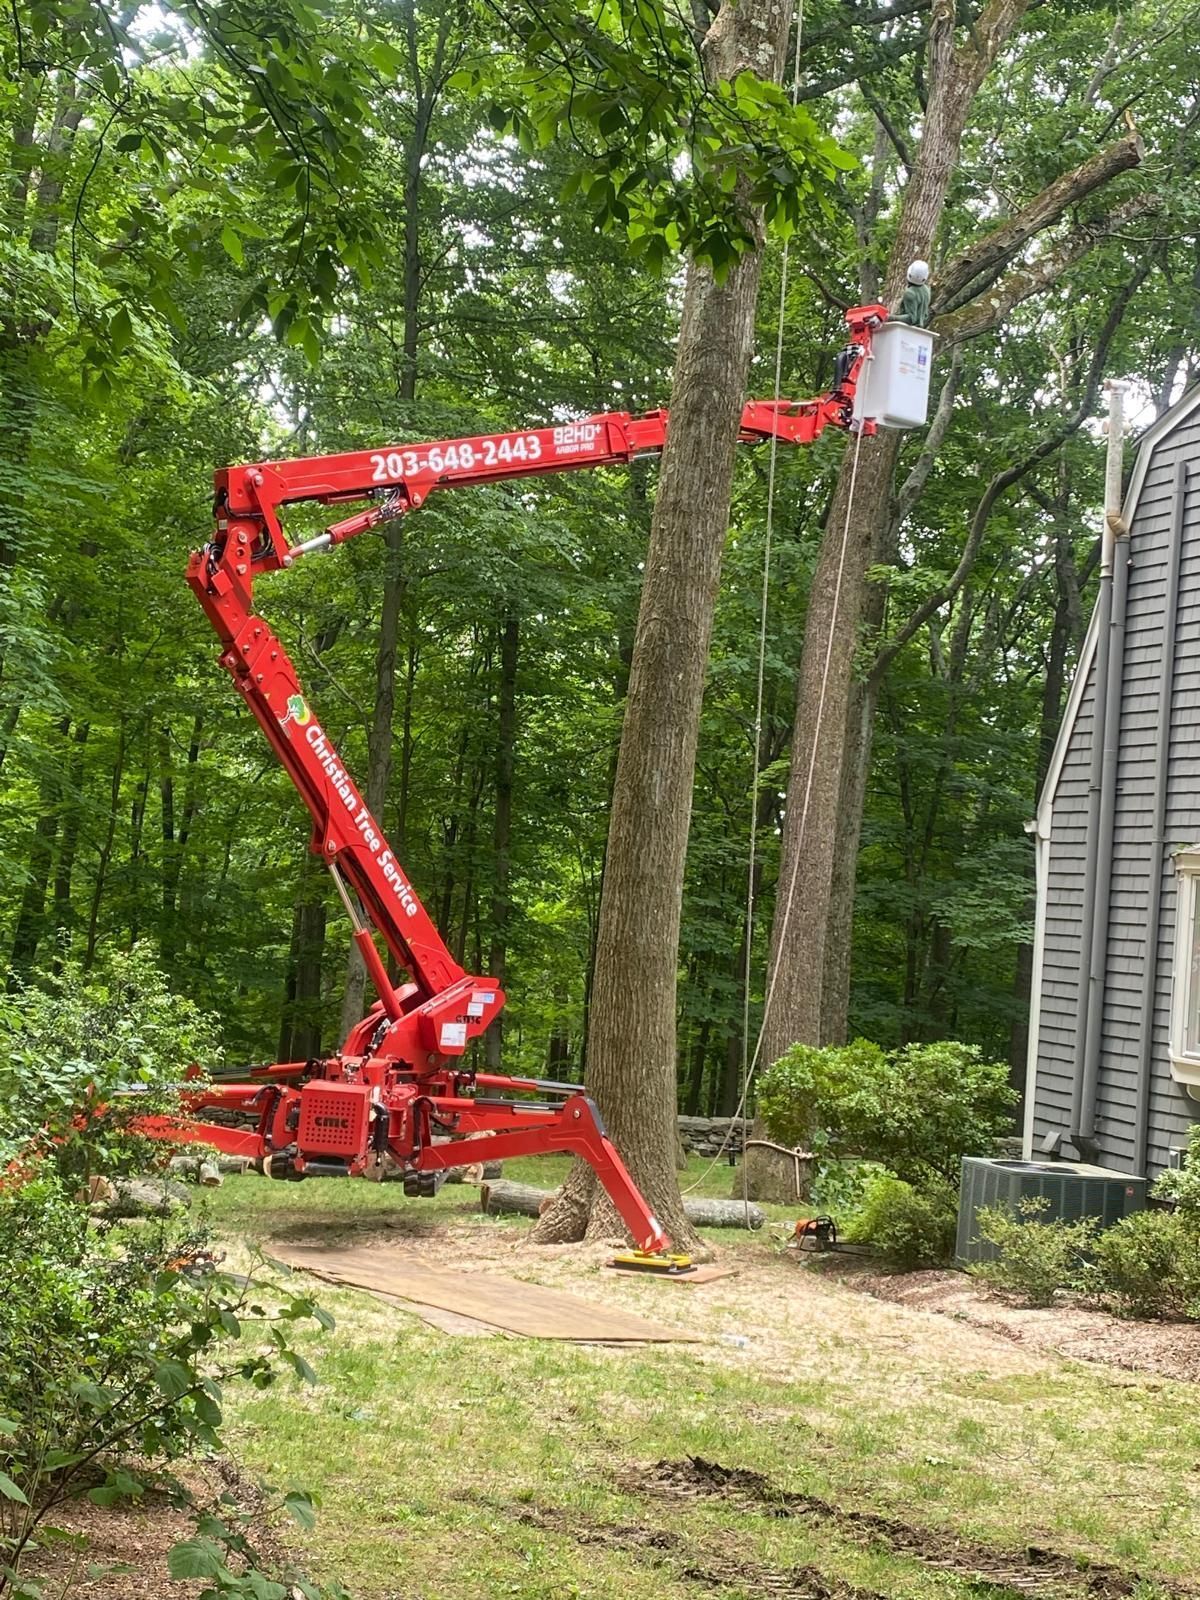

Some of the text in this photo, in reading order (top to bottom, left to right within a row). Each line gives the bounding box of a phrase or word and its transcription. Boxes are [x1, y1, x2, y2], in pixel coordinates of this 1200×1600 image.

[370, 435, 542, 481] 203-648-2443
[580, 442, 595, 452] PRO
[305, 725, 417, 917] Christian Tree Service
